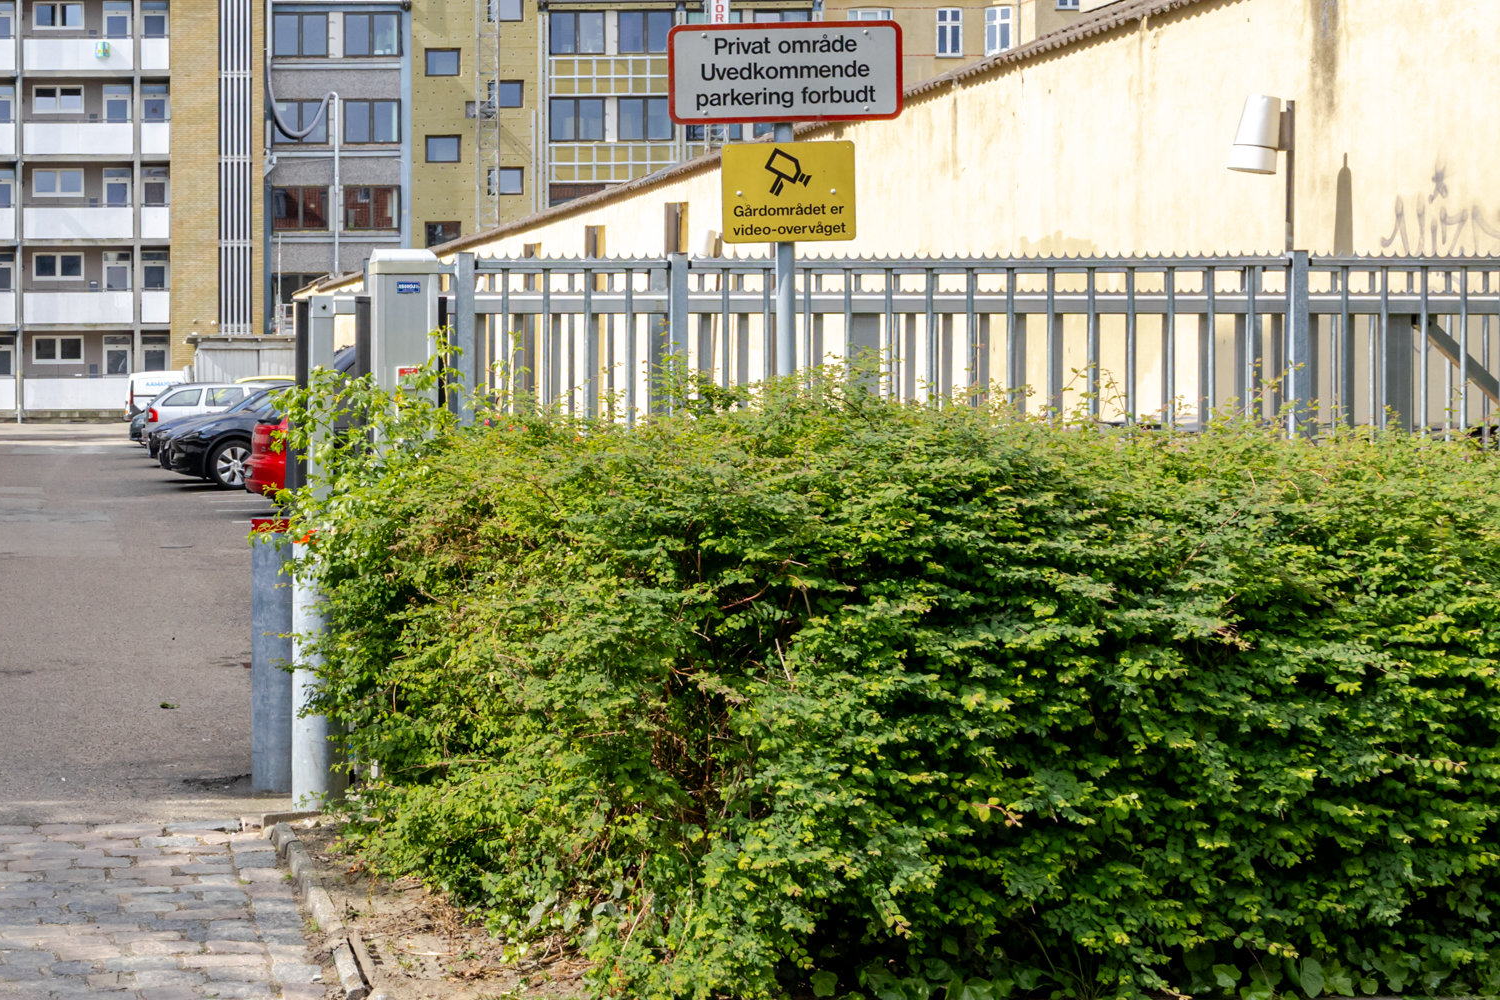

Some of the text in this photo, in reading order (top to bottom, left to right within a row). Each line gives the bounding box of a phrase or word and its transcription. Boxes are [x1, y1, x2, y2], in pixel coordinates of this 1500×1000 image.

[714, 34, 857, 55] Privat område
[701, 60, 870, 81] Uvedkommende
[696, 85, 876, 111] parkering forbudt
[733, 203, 844, 217] Gårdområdet er
[733, 221, 846, 236] video-overvåget
